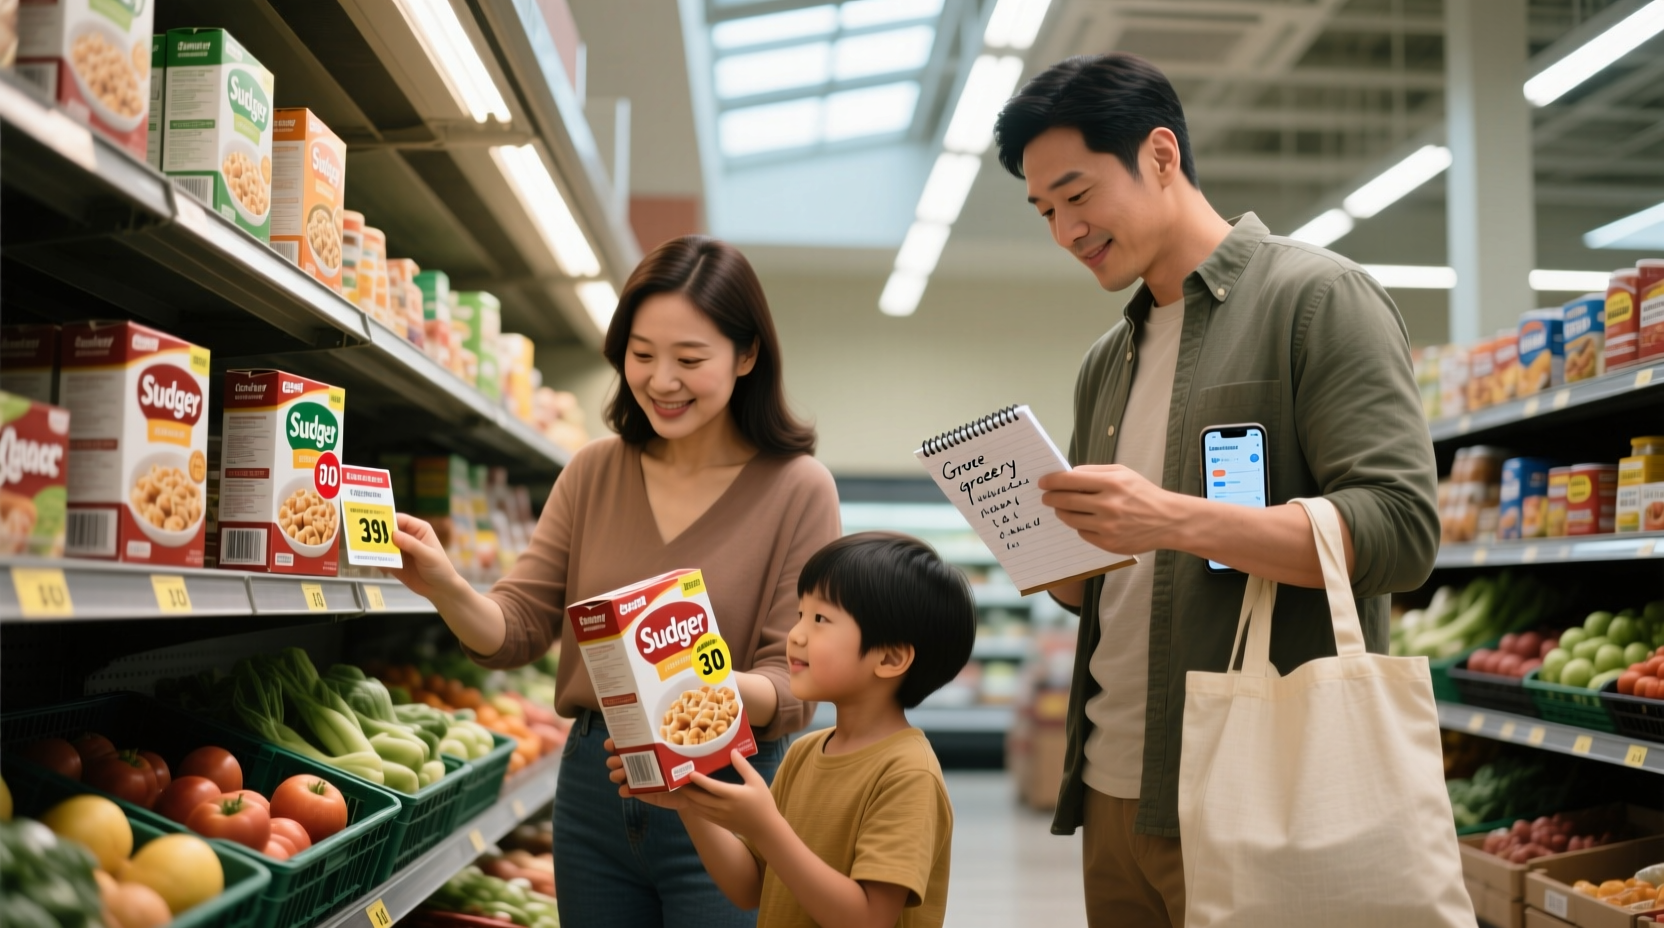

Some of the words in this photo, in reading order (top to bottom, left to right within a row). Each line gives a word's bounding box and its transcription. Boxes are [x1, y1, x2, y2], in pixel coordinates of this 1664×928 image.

[141, 374, 201, 419] Sudger
[289, 411, 337, 449] Sudger
[640, 613, 704, 654] Sudger
[698, 648, 725, 676] 30
